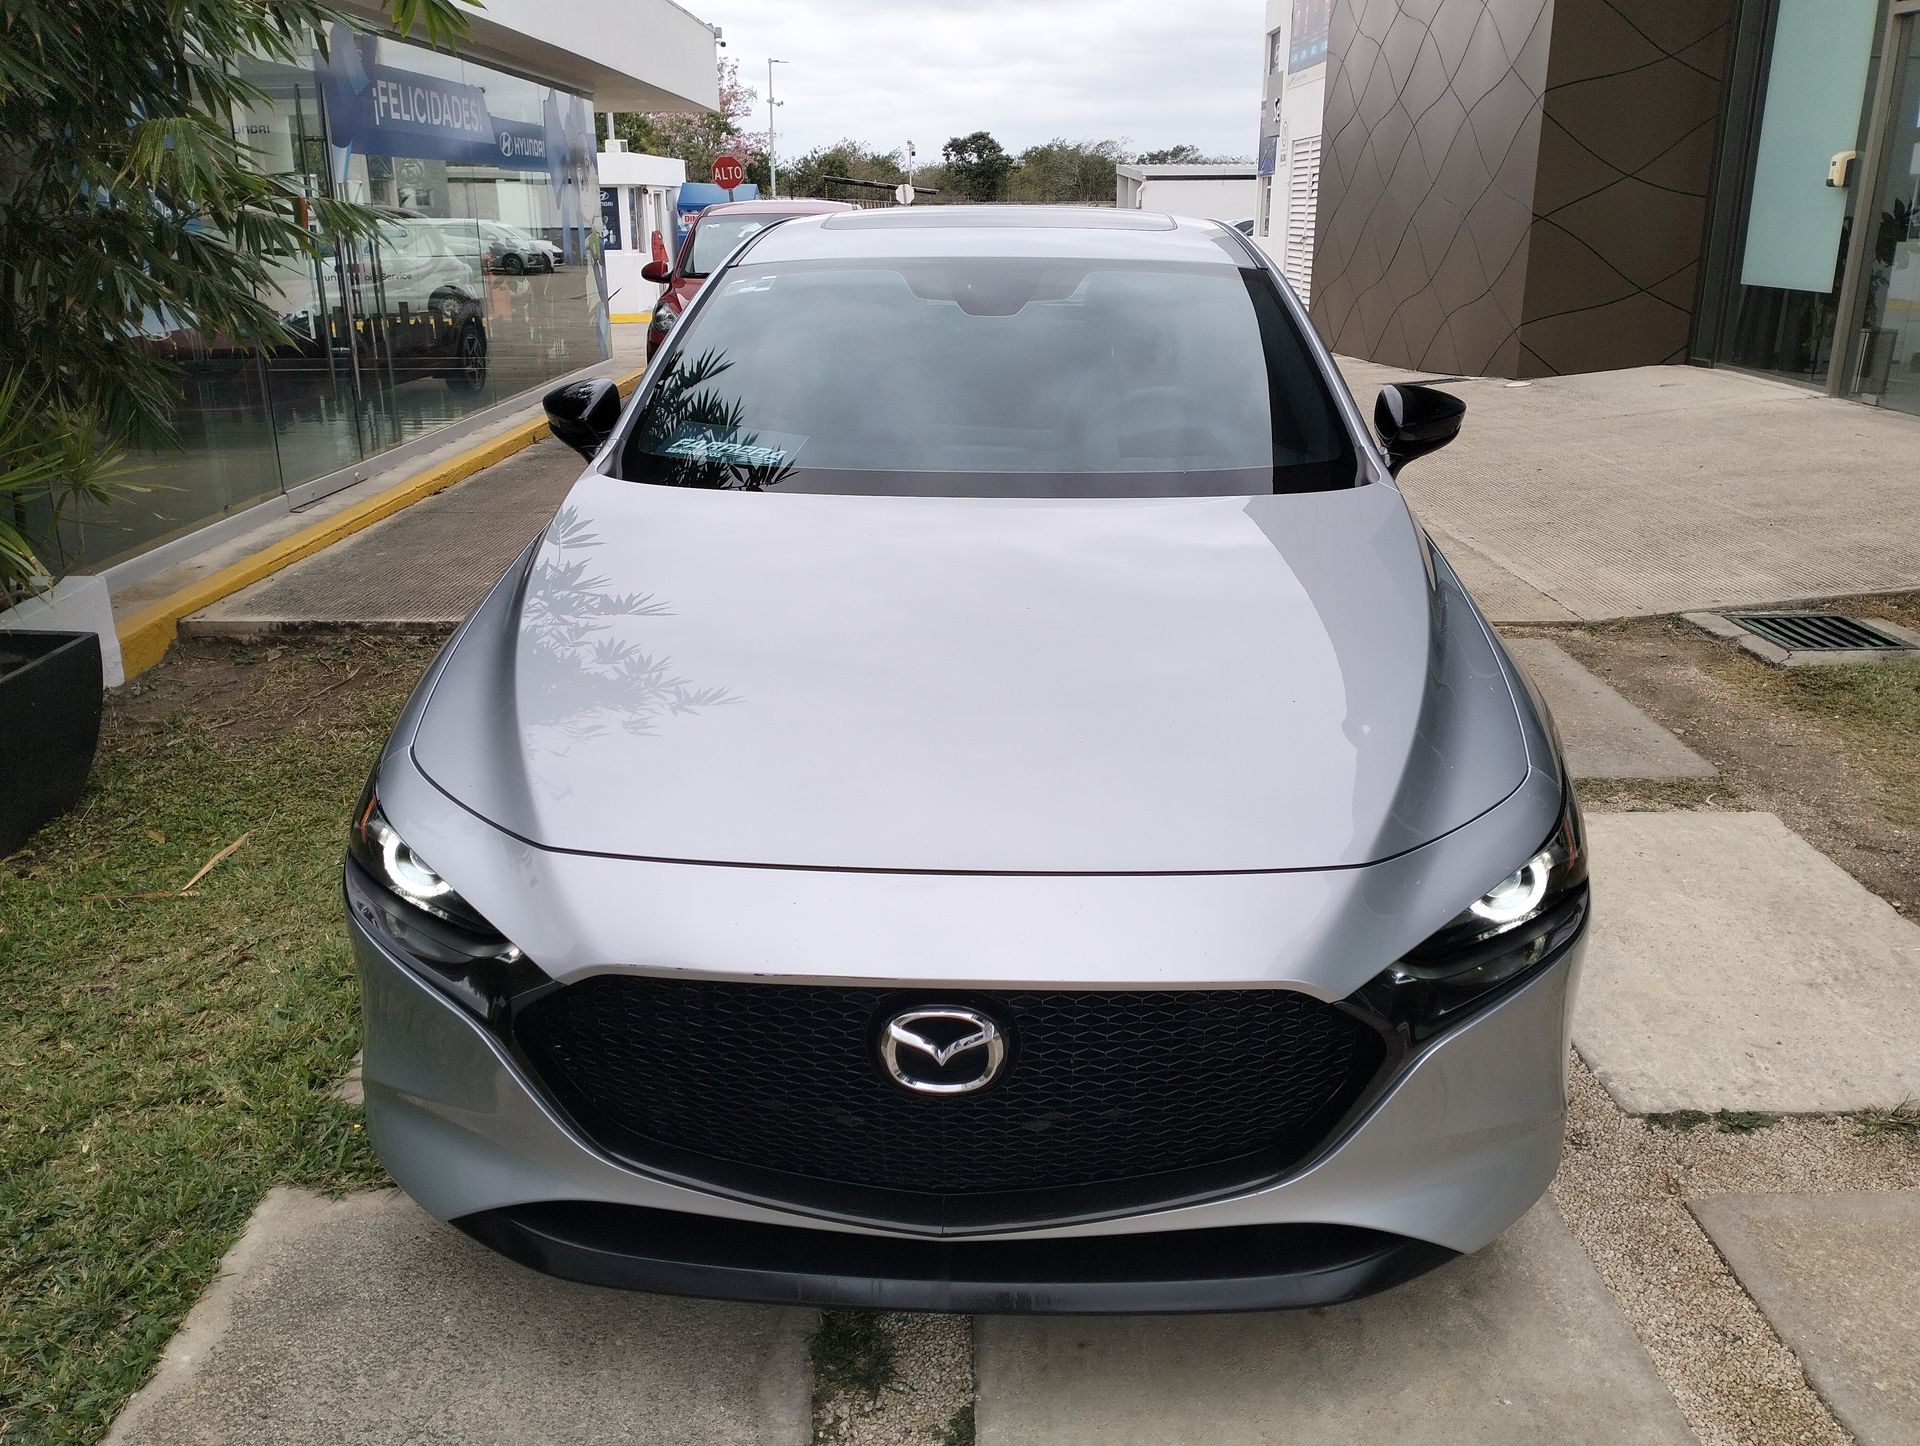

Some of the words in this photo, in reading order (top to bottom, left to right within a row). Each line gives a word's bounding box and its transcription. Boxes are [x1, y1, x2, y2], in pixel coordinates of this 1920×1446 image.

[373, 80, 483, 132] ¡FELICIDADES!
[513, 137, 546, 158] HYUNDAI
[714, 166, 743, 181] ALTO
